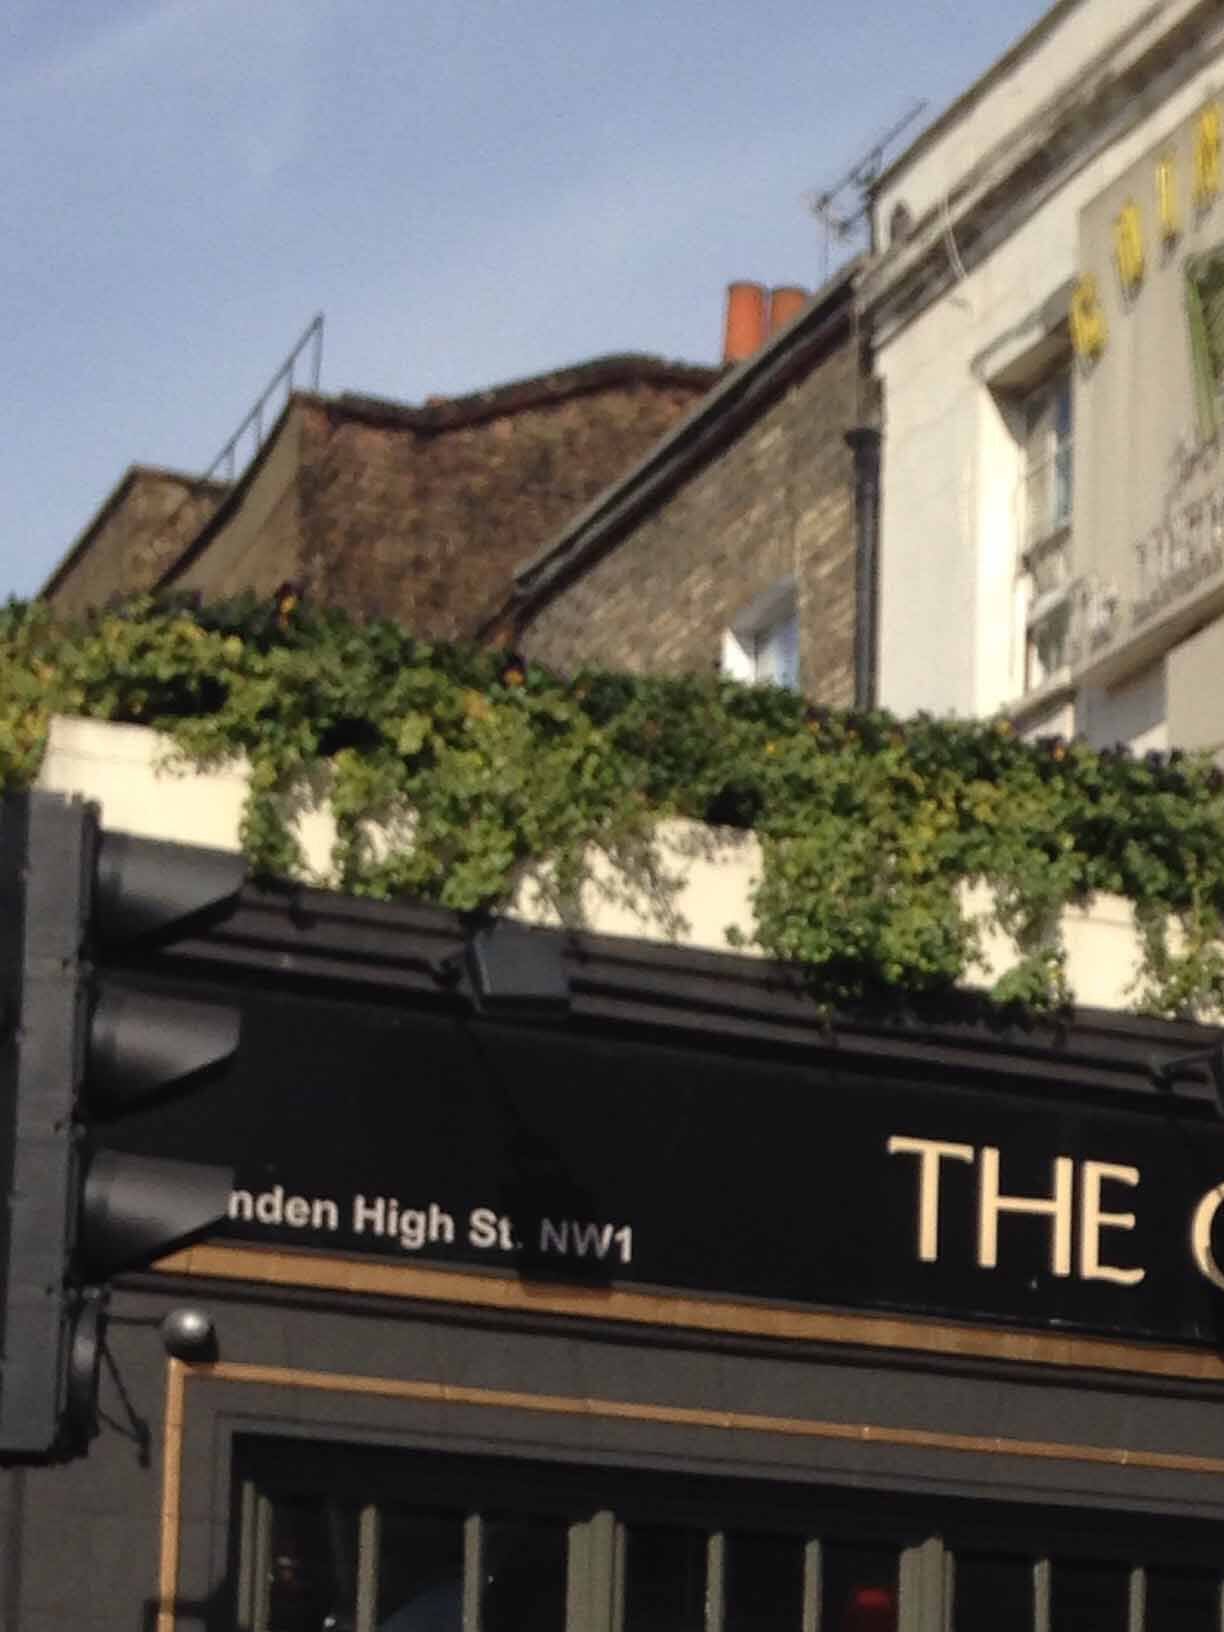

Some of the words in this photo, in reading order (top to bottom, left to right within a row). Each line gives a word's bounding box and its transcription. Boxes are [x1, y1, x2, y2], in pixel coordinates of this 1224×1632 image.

[353, 1194, 455, 1250] High
[540, 1218, 633, 1264] NW1
[887, 1135, 1145, 1285] THE
